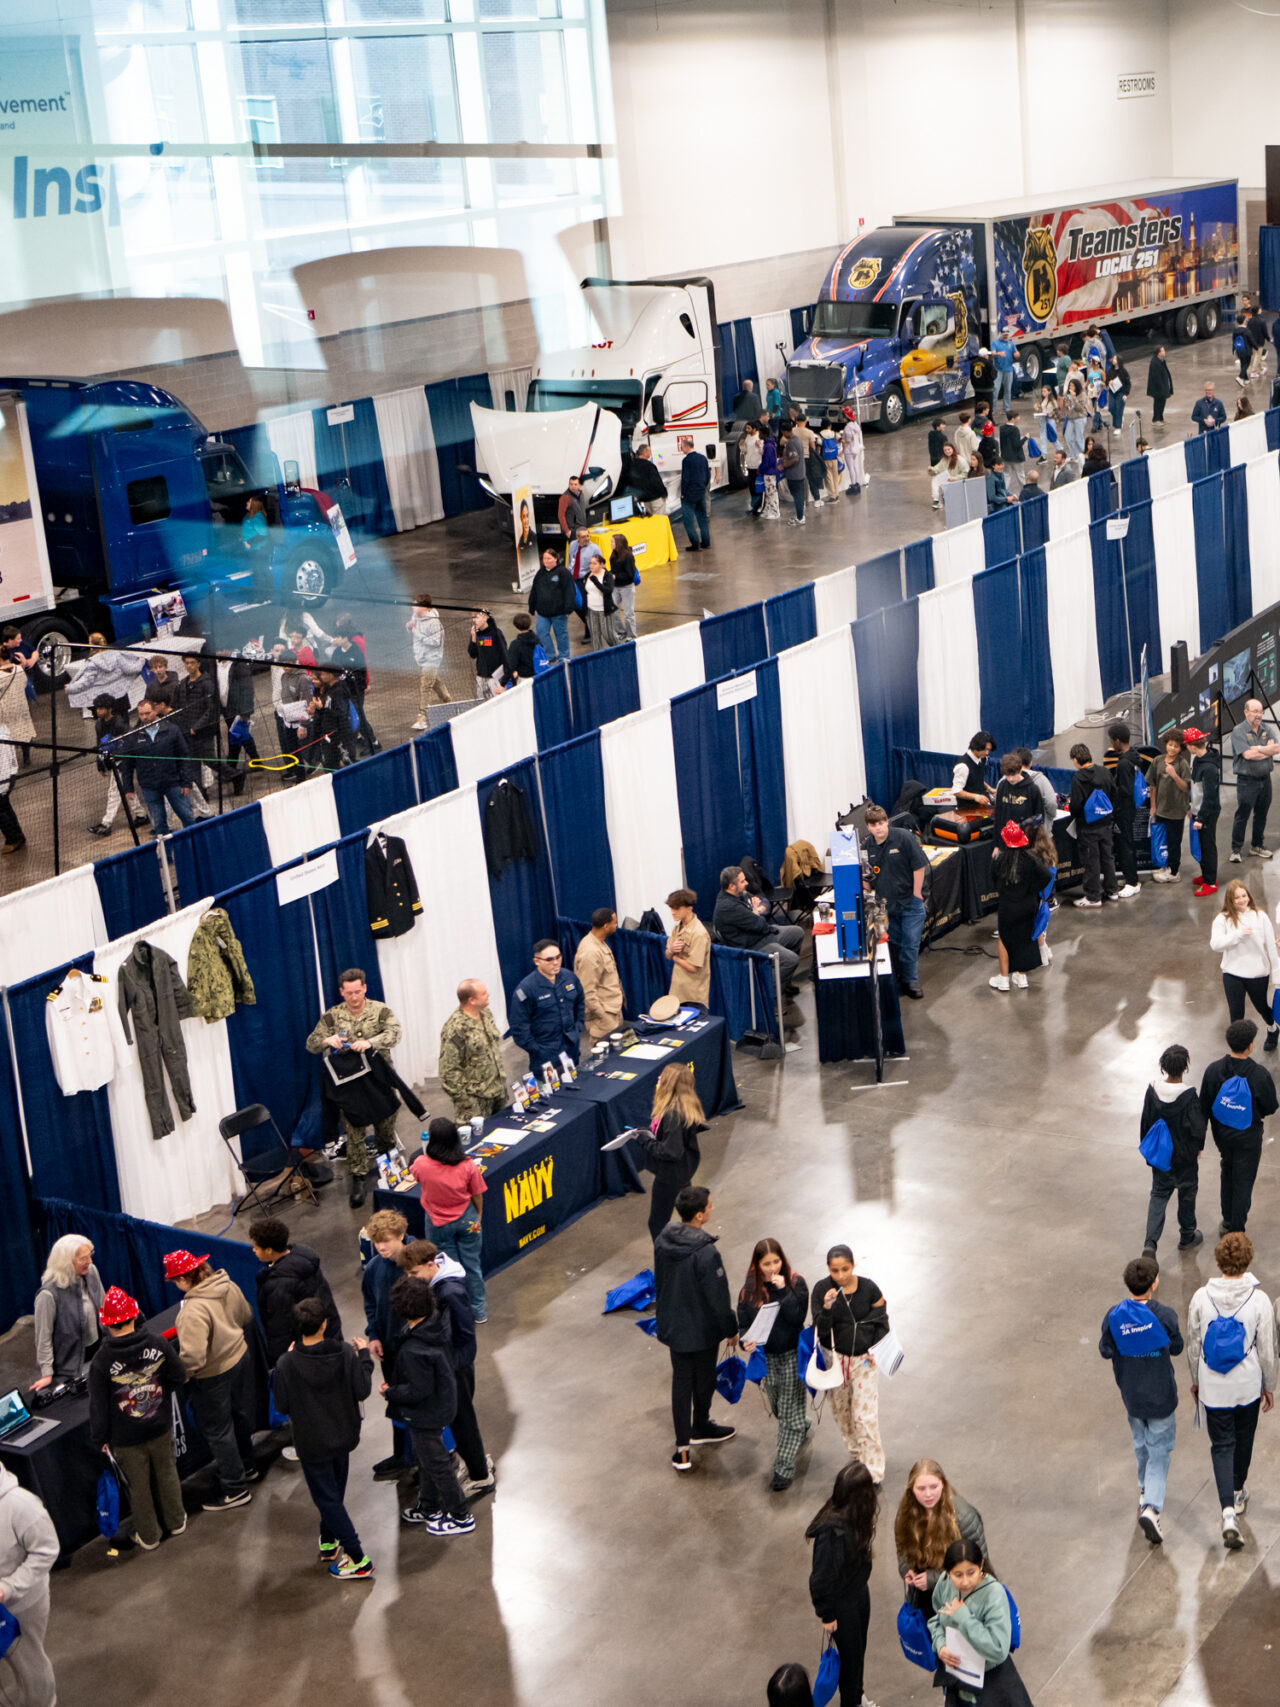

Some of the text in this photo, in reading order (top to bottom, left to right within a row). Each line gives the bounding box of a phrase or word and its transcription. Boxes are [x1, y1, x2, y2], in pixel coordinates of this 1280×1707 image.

[1119, 77, 1156, 92] RESTROOMS
[1067, 215, 1183, 263] Teamsters
[1095, 249, 1159, 278] LOCAL 251
[1040, 298, 1050, 311] 251
[503, 1155, 553, 1187] AMERICA'S
[503, 1160, 554, 1224] NAVY
[518, 1224, 546, 1248] NAVY.COM
